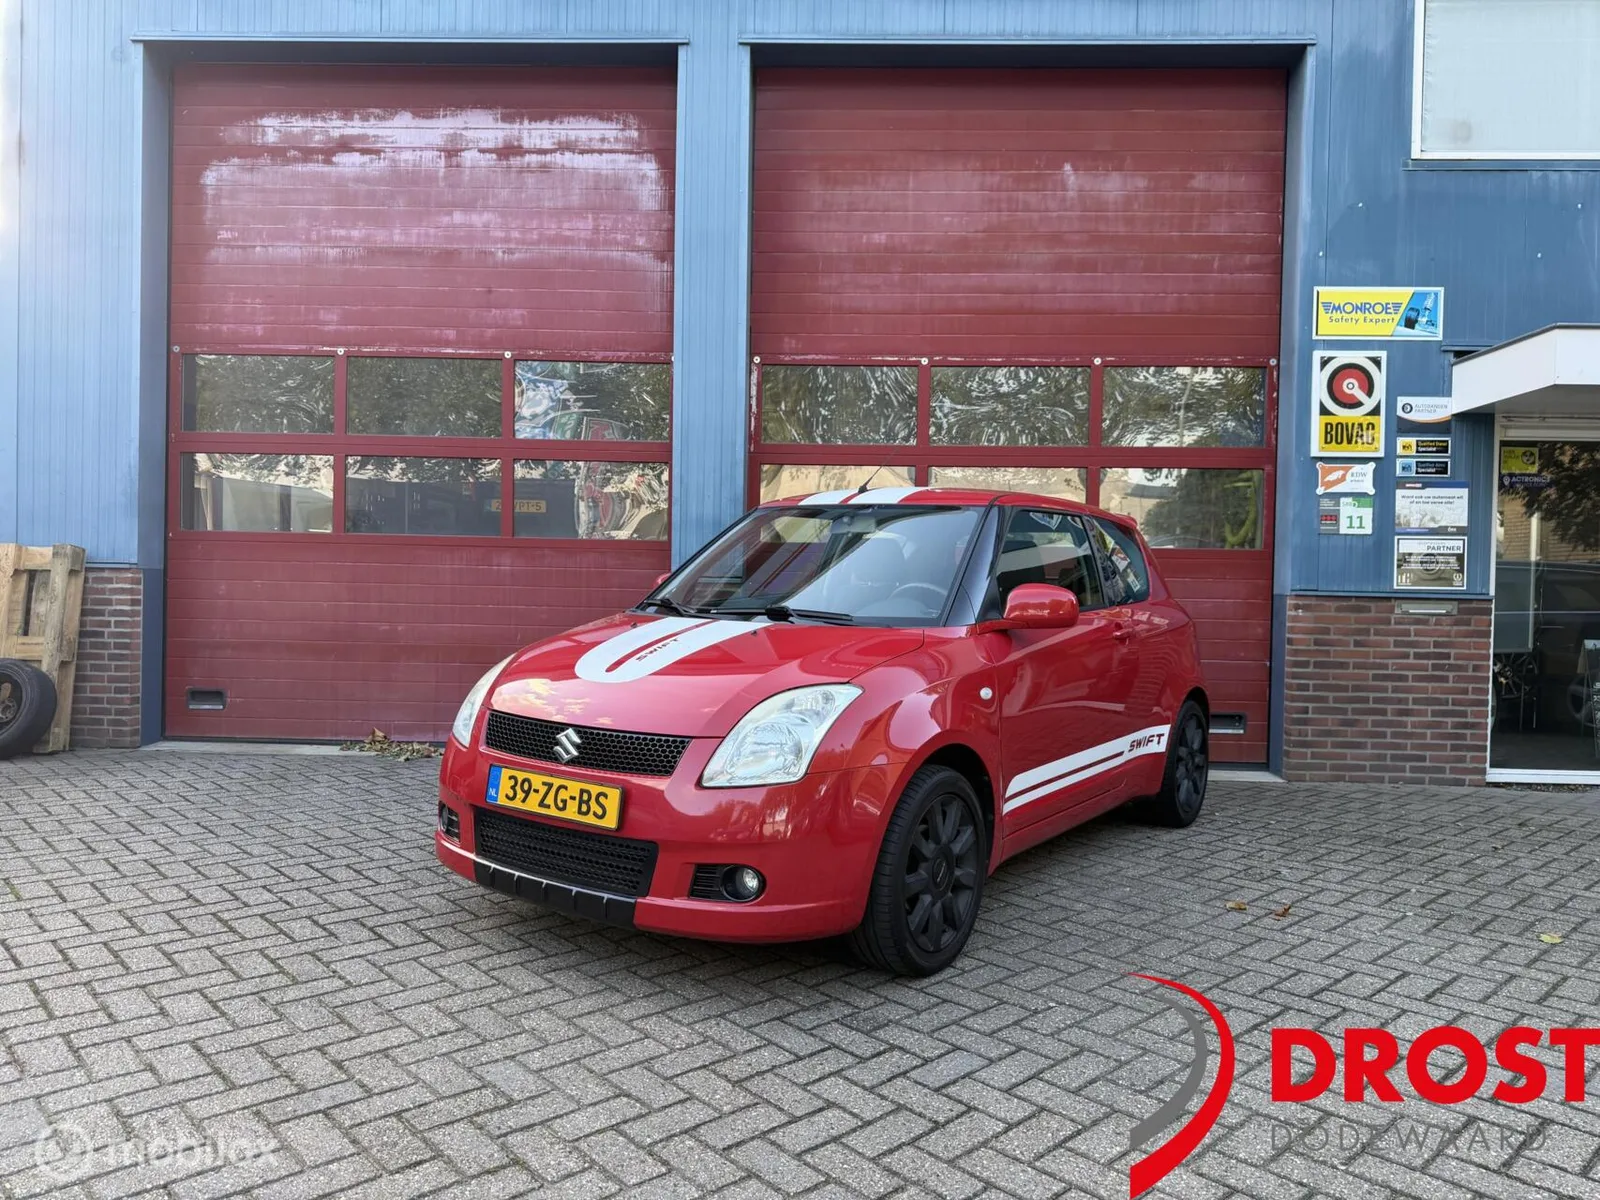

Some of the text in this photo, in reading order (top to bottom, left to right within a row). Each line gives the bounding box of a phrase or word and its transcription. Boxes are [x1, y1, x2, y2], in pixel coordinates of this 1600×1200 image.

[1330, 301, 1393, 314] MONROE
[1329, 316, 1395, 326] Safety Expert
[1346, 515, 1366, 529] 11
[635, 638, 679, 661] SWIFT
[1128, 733, 1165, 753] SWIFT
[488, 775, 608, 820] NL 39-ZG-BS
